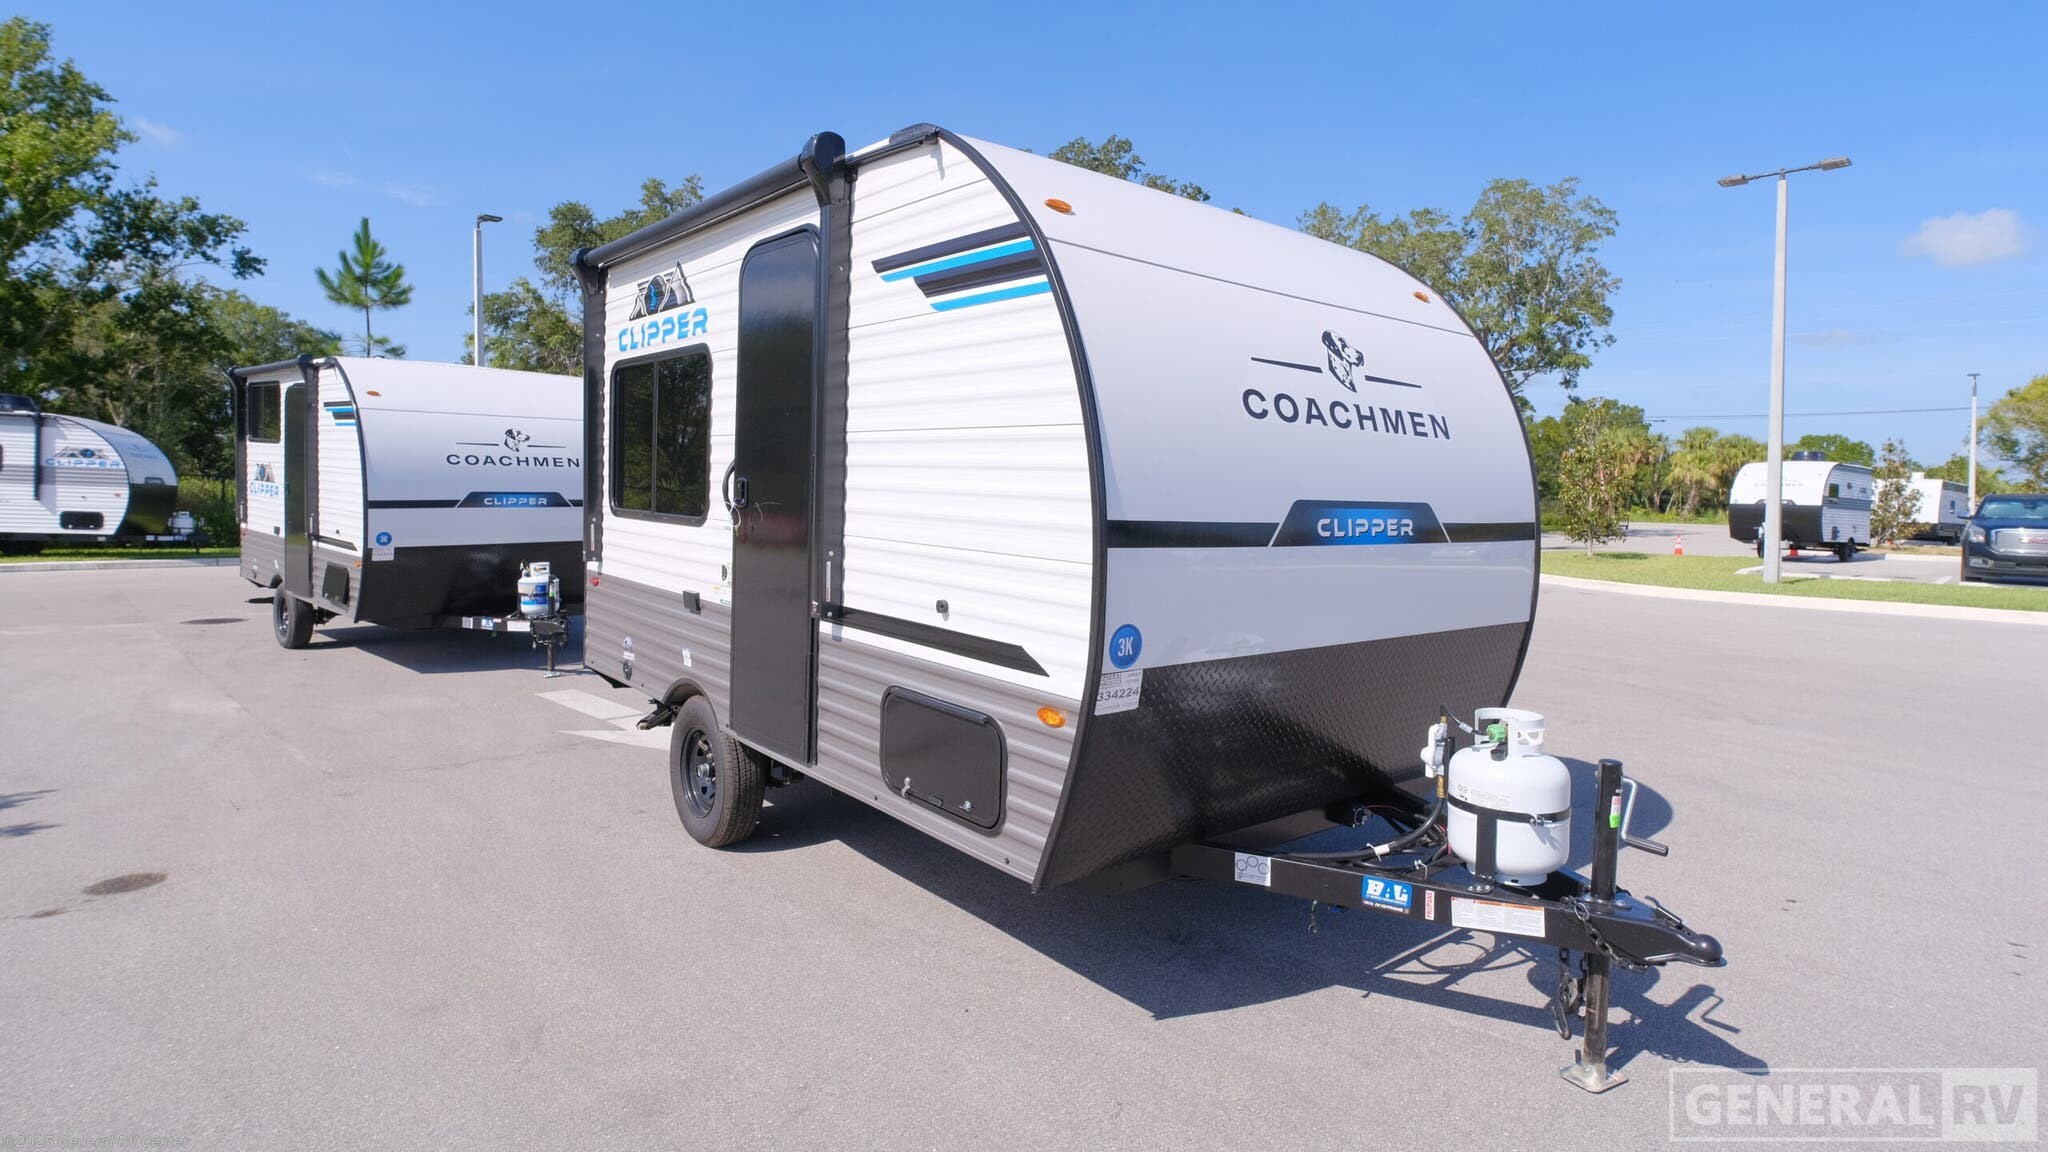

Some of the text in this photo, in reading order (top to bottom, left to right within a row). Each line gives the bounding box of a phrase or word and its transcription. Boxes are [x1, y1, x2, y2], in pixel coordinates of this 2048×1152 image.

[618, 307, 708, 352] CLIPPER
[1242, 388, 1451, 440] COACHMEN
[45, 457, 122, 469] CLIPPER
[446, 454, 580, 468] COACHMEN
[250, 481, 280, 497] CLIPPER
[483, 497, 548, 505] CLIPPER
[1317, 518, 1415, 537] CLIPPER
[1117, 636, 1134, 657] 3K
[1096, 686, 1140, 703] 334224
